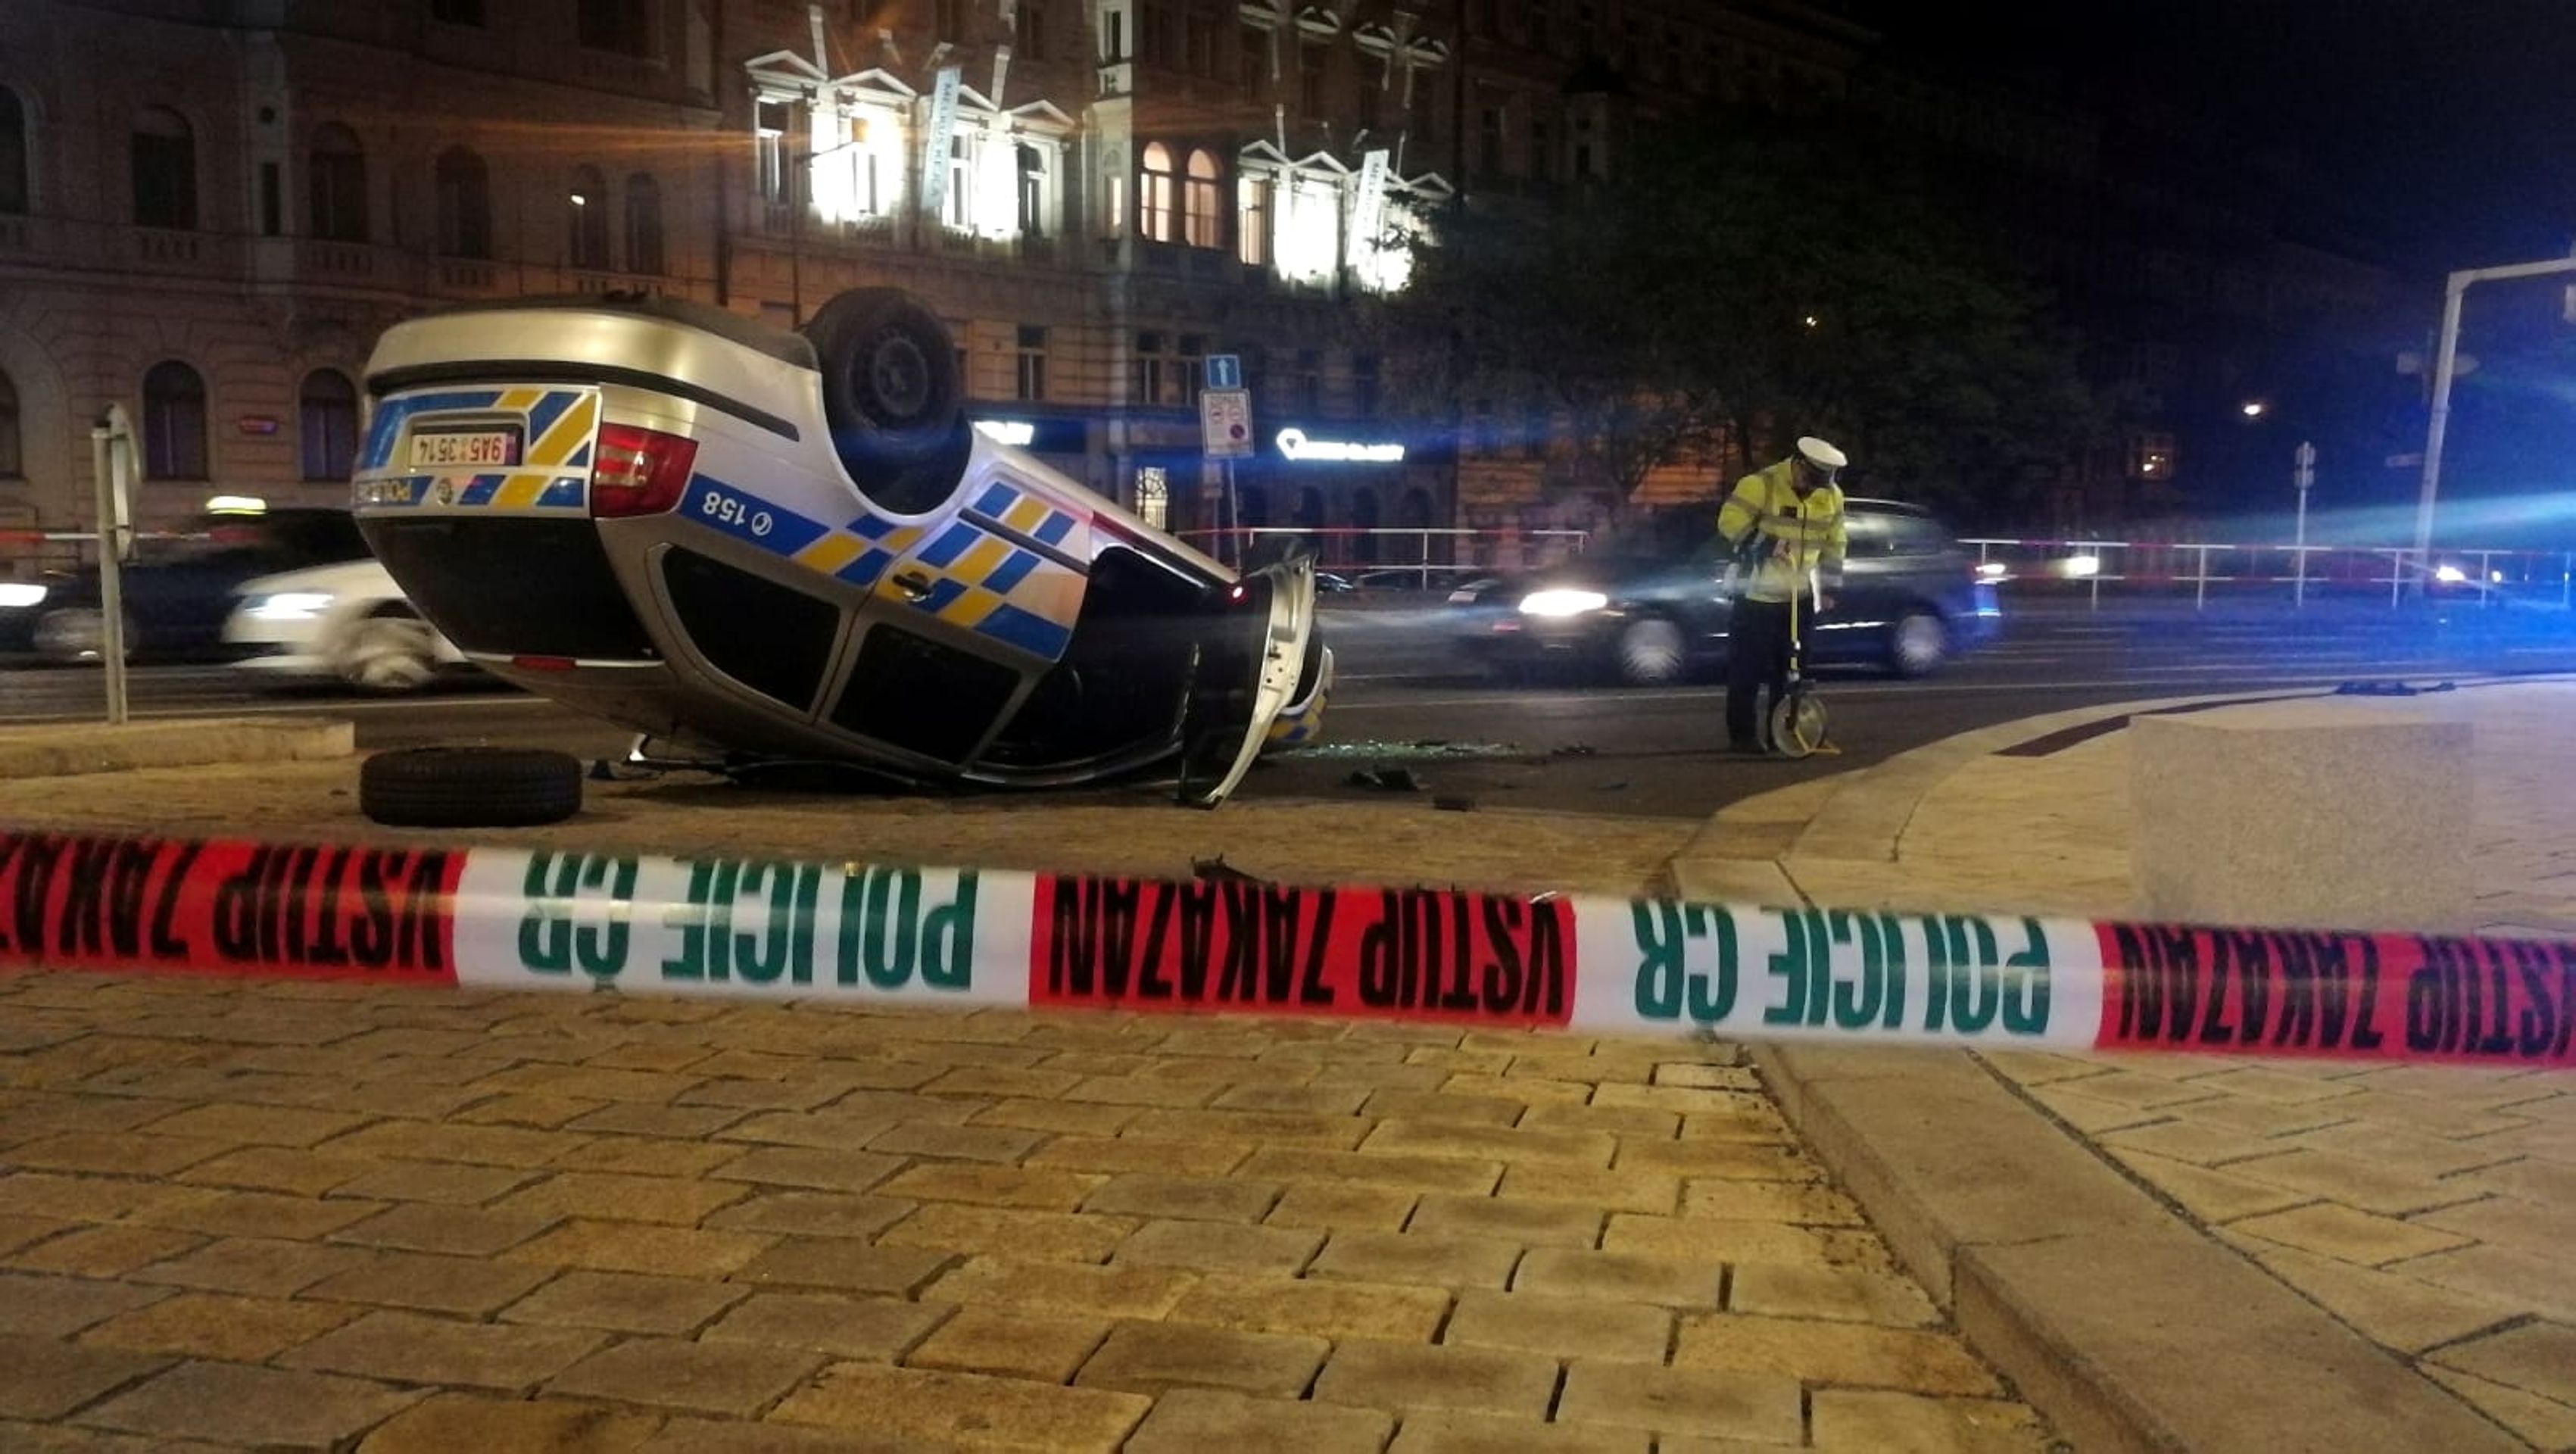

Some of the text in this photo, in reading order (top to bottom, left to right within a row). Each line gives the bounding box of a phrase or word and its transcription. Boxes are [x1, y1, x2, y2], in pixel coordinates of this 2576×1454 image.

[418, 435, 502, 463] 9A5 3514
[702, 491, 746, 526] 158
[212, 842, 444, 971] VSTUP
[1358, 888, 1564, 1016] VSTUP
